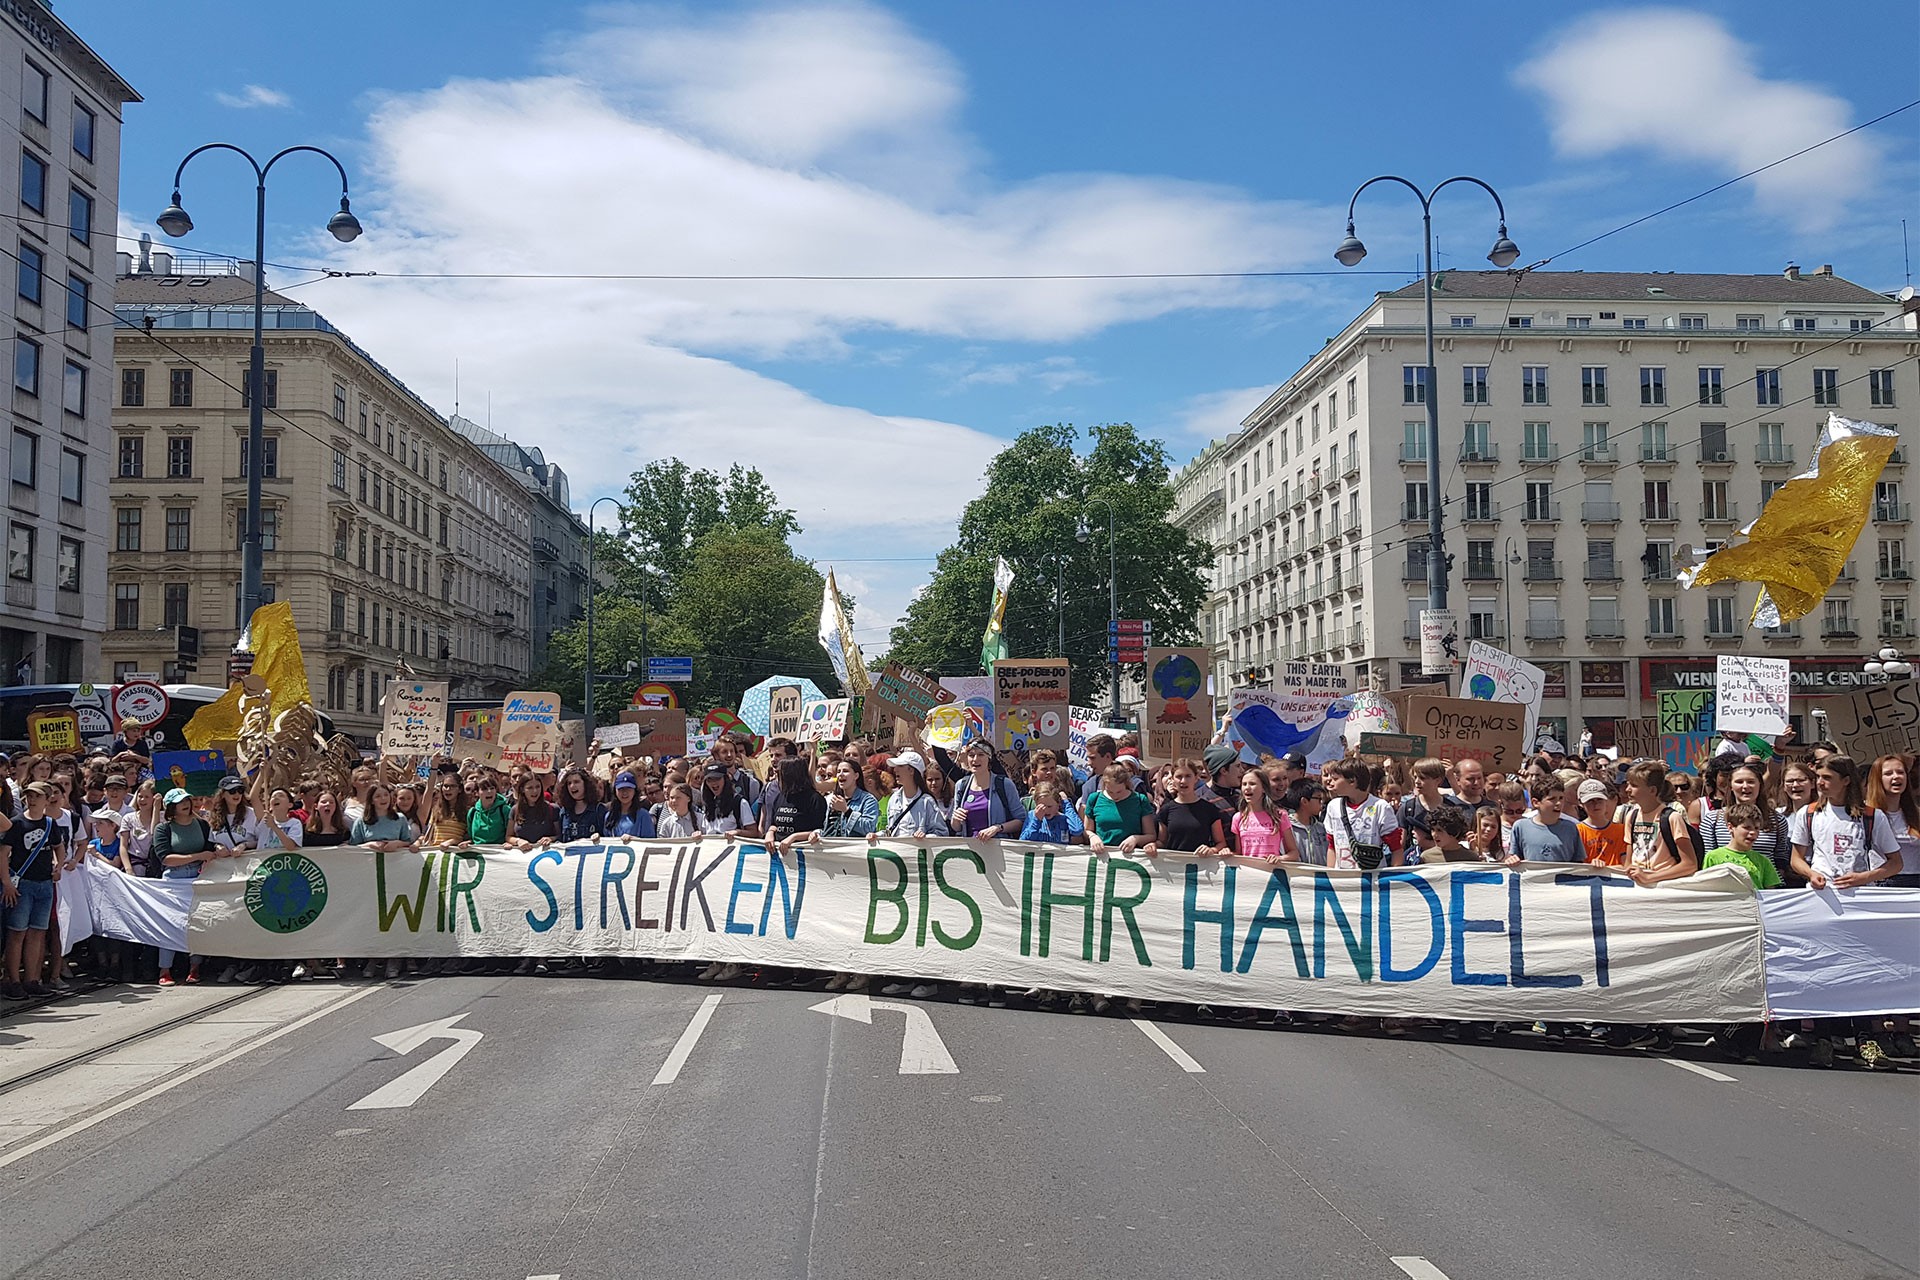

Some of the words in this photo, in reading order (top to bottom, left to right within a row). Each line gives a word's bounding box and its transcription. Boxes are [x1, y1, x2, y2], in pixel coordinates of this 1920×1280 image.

[1472, 643, 1488, 656] OH
[1489, 649, 1507, 665] SHIT
[1286, 663, 1307, 674] THIS
[1312, 664, 1342, 676] EARTH
[1469, 657, 1511, 686] MELTING
[999, 678, 1020, 689] Our
[1022, 678, 1059, 688] house
[1284, 676, 1302, 687] WAS
[1306, 677, 1329, 687] MADE
[1332, 678, 1347, 688] FOR
[1722, 680, 1753, 692] global
[120, 686, 162, 702] STRASSENBAHN
[397, 689, 422, 701] Roses
[878, 686, 899, 704] OUR
[1000, 689, 1010, 699] is
[1721, 692, 1738, 702] We
[1743, 692, 1787, 703] NEED
[409, 702, 427, 711] Red
[506, 699, 553, 713] Microtus
[775, 697, 797, 712] ACT
[1661, 693, 1679, 712] ES
[507, 713, 554, 724] bavaricus
[803, 703, 846, 722] LOVE
[1070, 707, 1101, 721] BEARS
[1721, 705, 1785, 719] Everyone!
[40, 721, 73, 733] HONEY
[390, 722, 403, 731] The
[774, 716, 798, 734] NOW
[1616, 720, 1639, 739] NON
[1434, 726, 1451, 739] ist
[1456, 728, 1480, 740] ein
[1154, 737, 1164, 748] IN
[1616, 739, 1640, 758] SED
[776, 815, 794, 823] PREFER
[265, 856, 292, 875] FOR
[296, 858, 326, 895] FUTURE
[278, 909, 317, 930] Wien
[376, 852, 485, 932] WIR
[525, 844, 806, 940] STREIKEN
[863, 848, 986, 951] BIS
[1020, 852, 1152, 967] IHR
[1182, 863, 1635, 988] HANDELT
